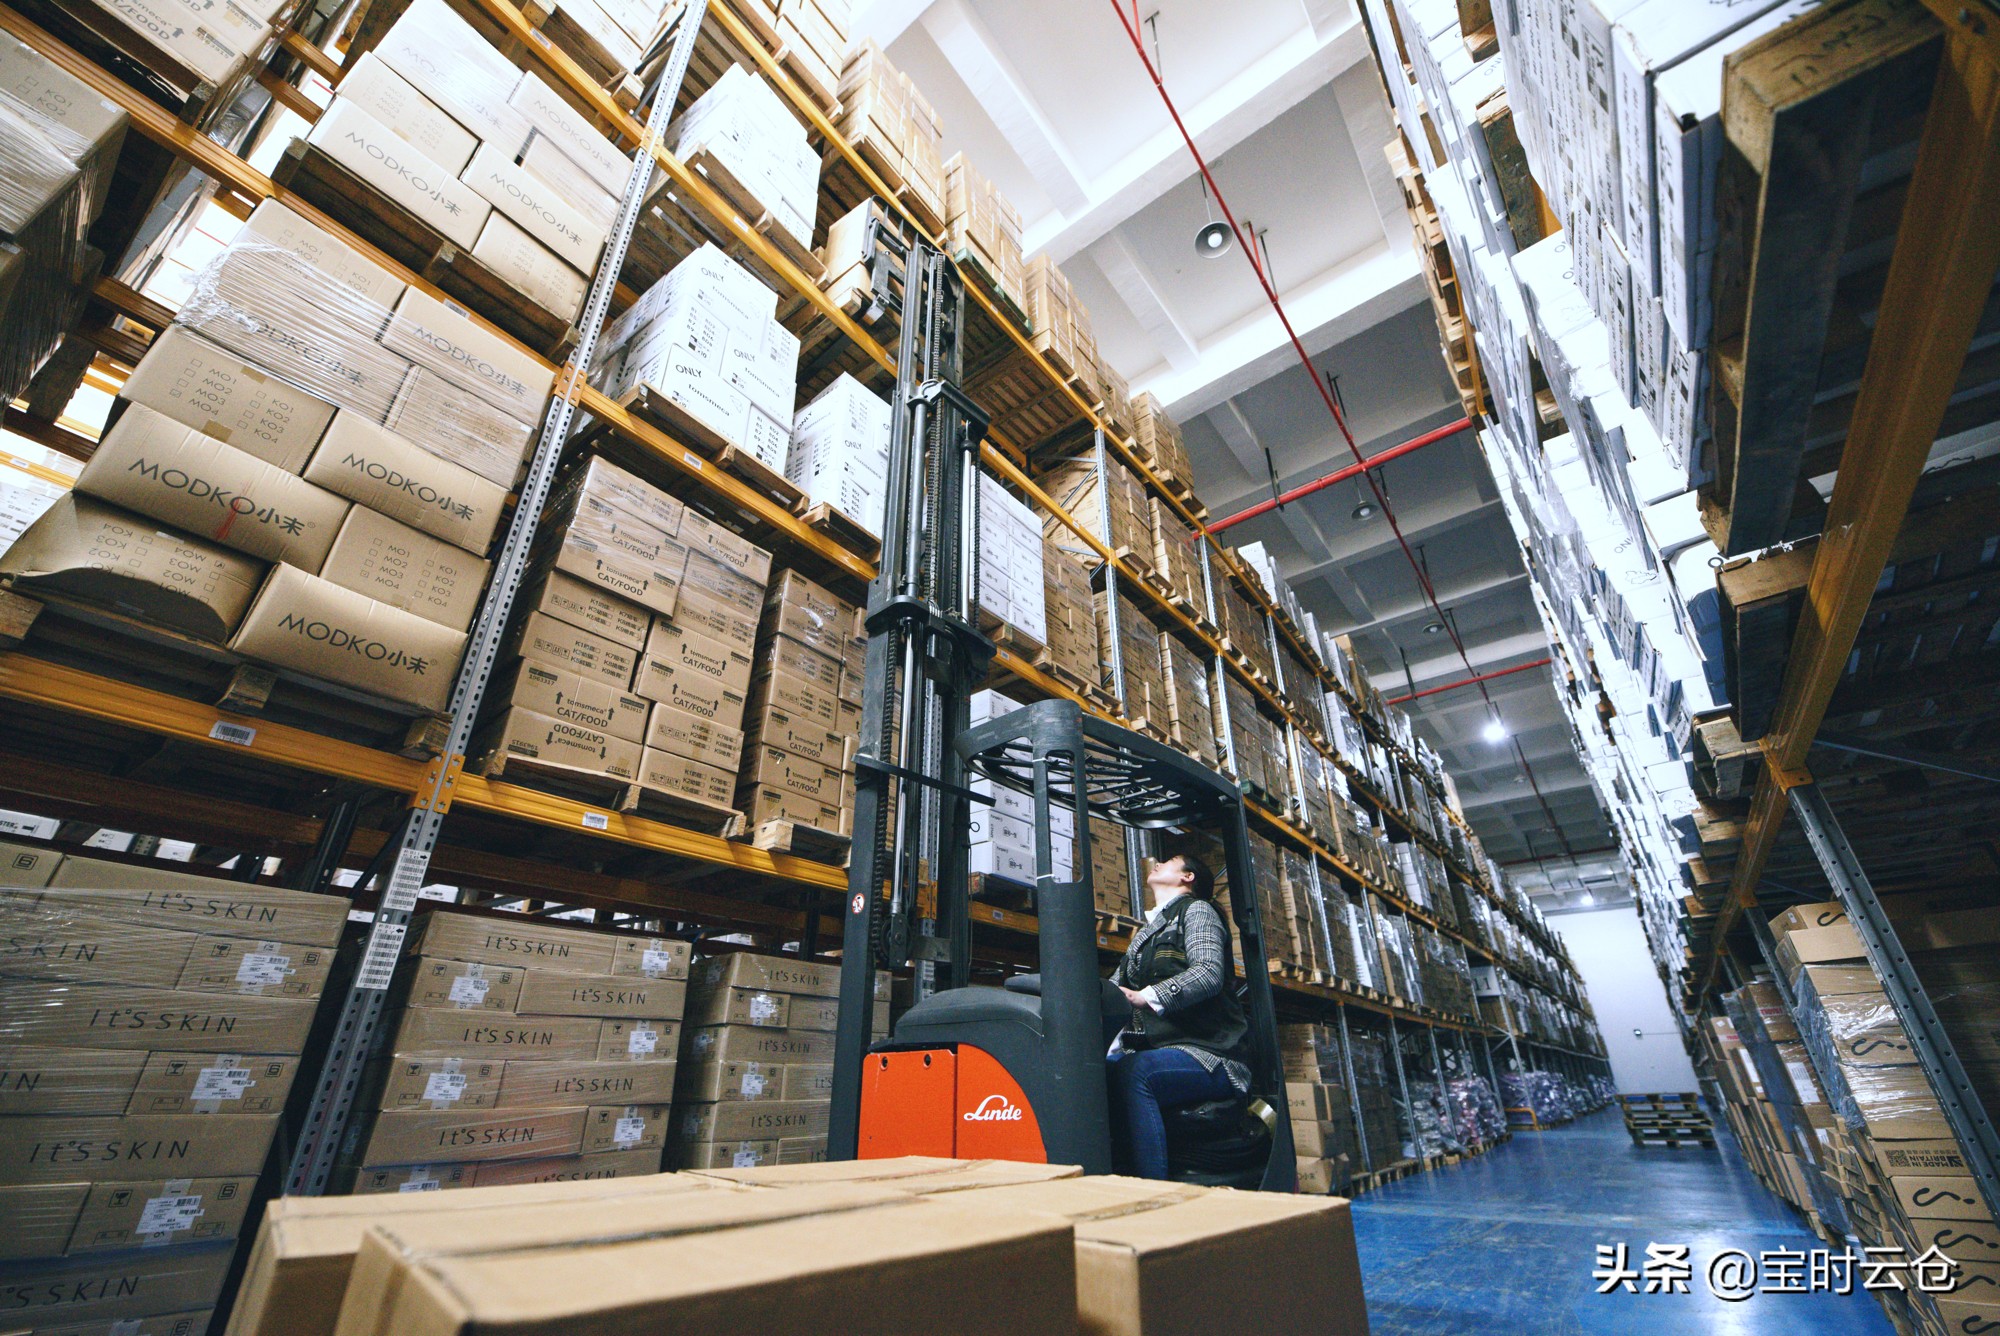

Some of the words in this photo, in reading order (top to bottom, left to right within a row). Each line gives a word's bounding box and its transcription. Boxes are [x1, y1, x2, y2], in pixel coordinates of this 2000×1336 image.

[701, 267, 725, 283] ONLY
[734, 348, 756, 362] ONLY
[209, 368, 237, 384] MO1
[675, 364, 702, 378] ONLY
[202, 378, 233, 395] MO2
[195, 388, 226, 406] MO3
[688, 384, 730, 417] tomsmeca
[188, 398, 219, 416] MO4
[271, 399, 294, 414] KO1
[266, 408, 290, 424] KO2
[259, 418, 285, 434] KO3
[253, 428, 279, 444] KO4
[102, 522, 133, 538] KO4
[95, 534, 127, 549] KO3
[612, 536, 655, 561] CAT/FOOD
[88, 547, 121, 561] KO2
[175, 546, 207, 562] MO4
[387, 544, 410, 558] MO1
[169, 558, 202, 573] MO3
[383, 555, 408, 569] MO2
[439, 564, 457, 576] KO1
[162, 570, 196, 586] MO2
[379, 565, 405, 580] MO3
[375, 576, 400, 591] MO4
[435, 575, 455, 587] KO2
[597, 572, 644, 596] CAT/FOOD
[431, 585, 452, 597] KO3
[427, 595, 448, 608] KO4
[683, 656, 722, 677] CAT/FOOD
[567, 698, 604, 714] tomsmeca
[673, 697, 714, 718] CAT/FOOD
[557, 707, 608, 728] CAT/FOOD
[554, 724, 605, 744] CAT/FOOD
[789, 742, 820, 758] CAT/FOOD
[787, 779, 819, 794] CAT/FOOD
[203, 896, 277, 922] SKIN
[8, 937, 98, 962] SKIN
[525, 940, 570, 957] SKIN
[792, 972, 821, 986] SKIN
[605, 991, 646, 1005] SKIN
[155, 1014, 237, 1033] SKIN
[505, 1030, 553, 1045] SKIN
[782, 1041, 811, 1053] SKIN
[589, 1078, 634, 1091] SKIN
[964, 1095, 1022, 1121] Linde
[776, 1115, 807, 1126] SKIN
[481, 1127, 535, 1143] SKIN
[101, 1139, 190, 1160] SKIN
[48, 1276, 140, 1302] SKIN
